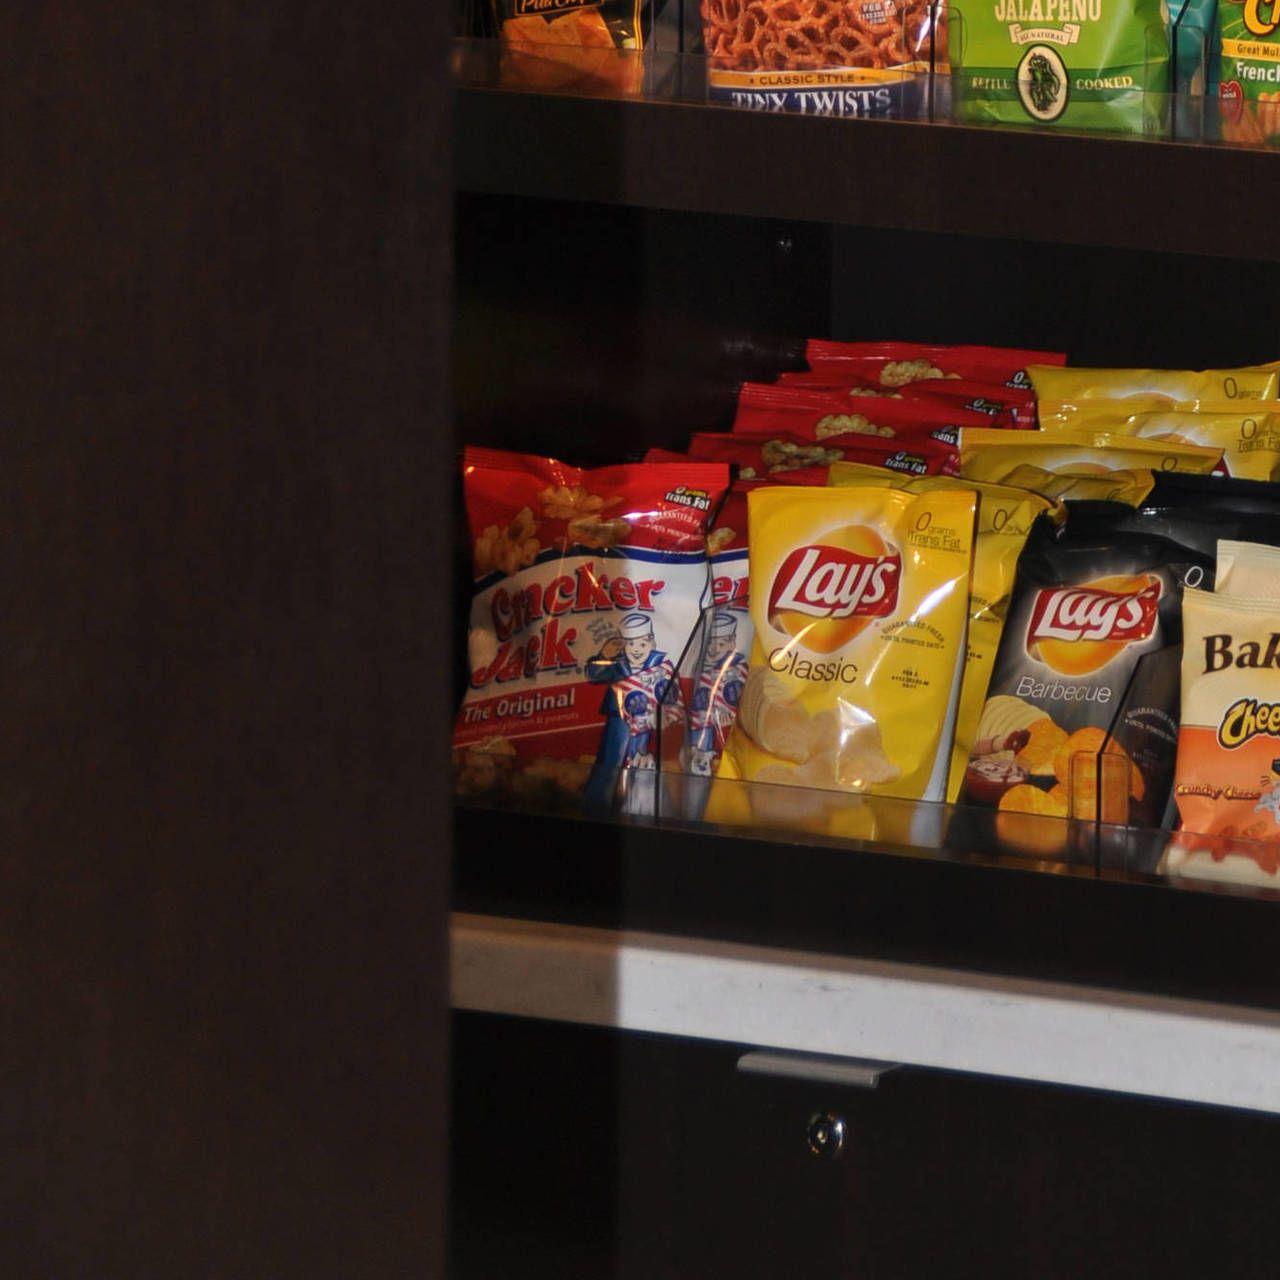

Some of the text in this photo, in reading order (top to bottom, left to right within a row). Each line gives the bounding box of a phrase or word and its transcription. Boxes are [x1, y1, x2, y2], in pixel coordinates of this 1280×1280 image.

[1237, 43, 1261, 56] Great
[759, 73, 855, 86] CLASSIC STYLE
[1076, 76, 1133, 90] COOKED
[795, 89, 891, 114] TWISTS
[694, 496, 711, 511] Fat
[941, 535, 961, 549] Fat
[775, 548, 897, 618] Lay's
[1033, 588, 1155, 641] Lay's
[768, 647, 858, 684] Classic
[1015, 675, 1112, 703] Barbecue
[464, 689, 576, 723] The Original
